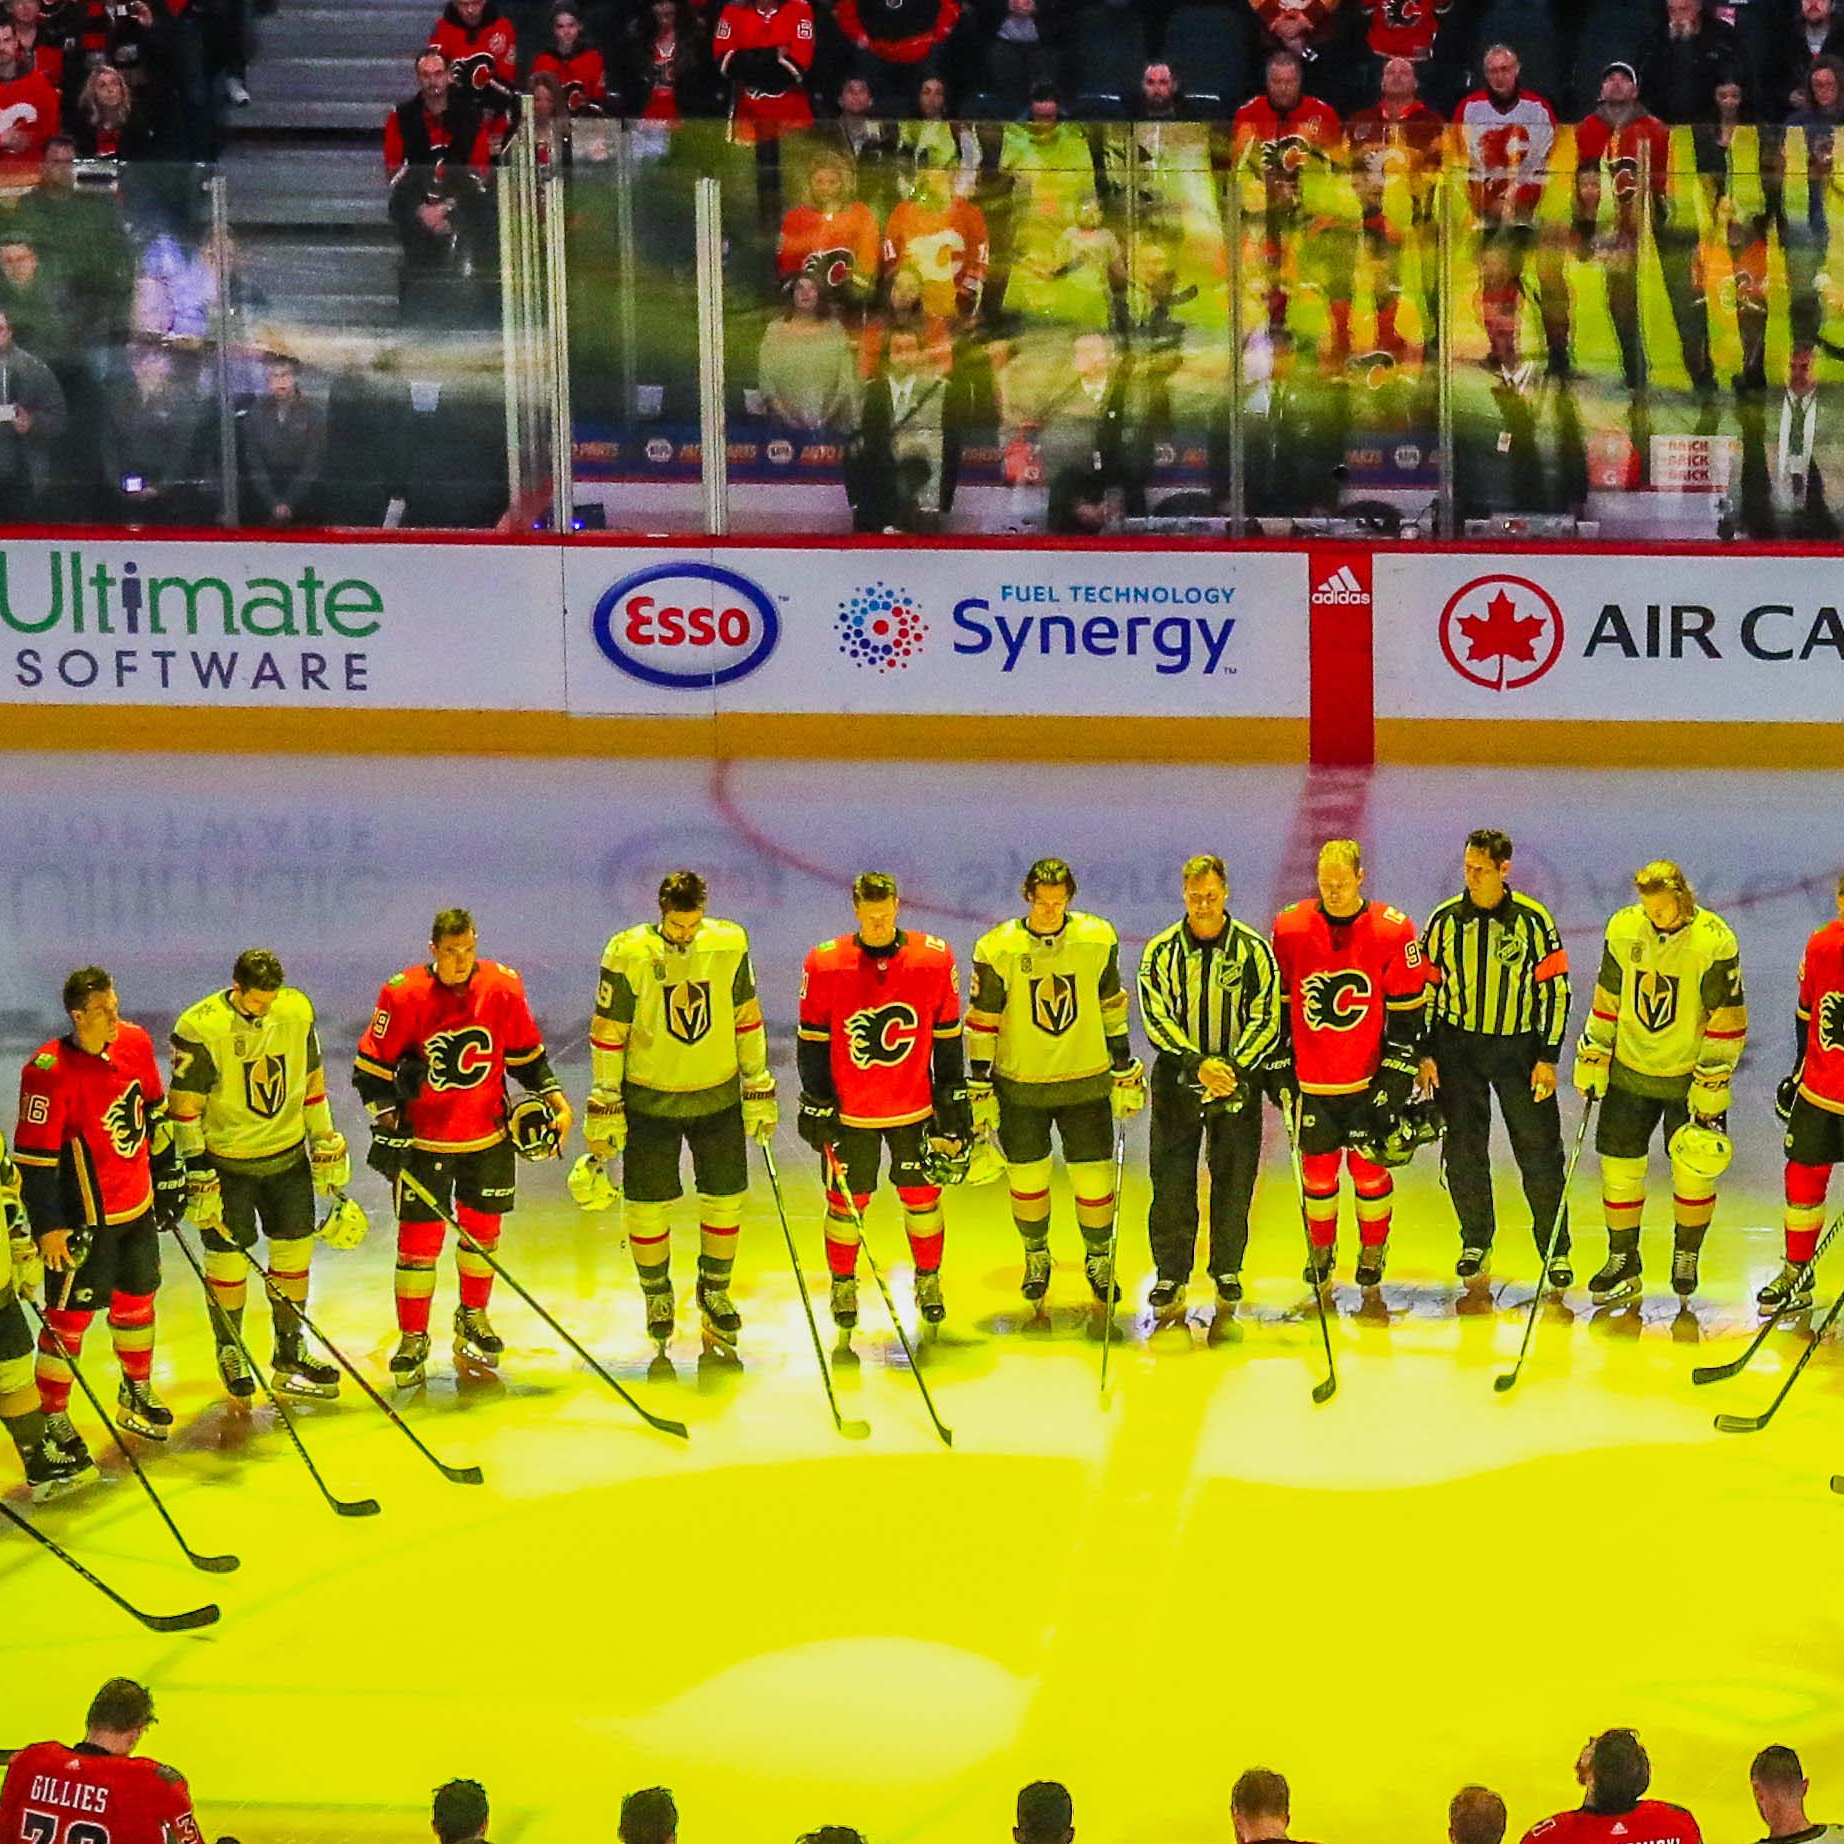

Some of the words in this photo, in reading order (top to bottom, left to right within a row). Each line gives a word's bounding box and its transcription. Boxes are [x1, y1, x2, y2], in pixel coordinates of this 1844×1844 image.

[1001, 585, 1060, 603] FUEL
[1069, 585, 1236, 604] TECHNOLOGY
[1311, 590, 1371, 606] adidas
[952, 599, 1237, 676] Synergy
[1583, 603, 1724, 659] AIR
[14, 648, 369, 693] SOFTWARE
[30, 1774, 110, 1815] GILLIES
